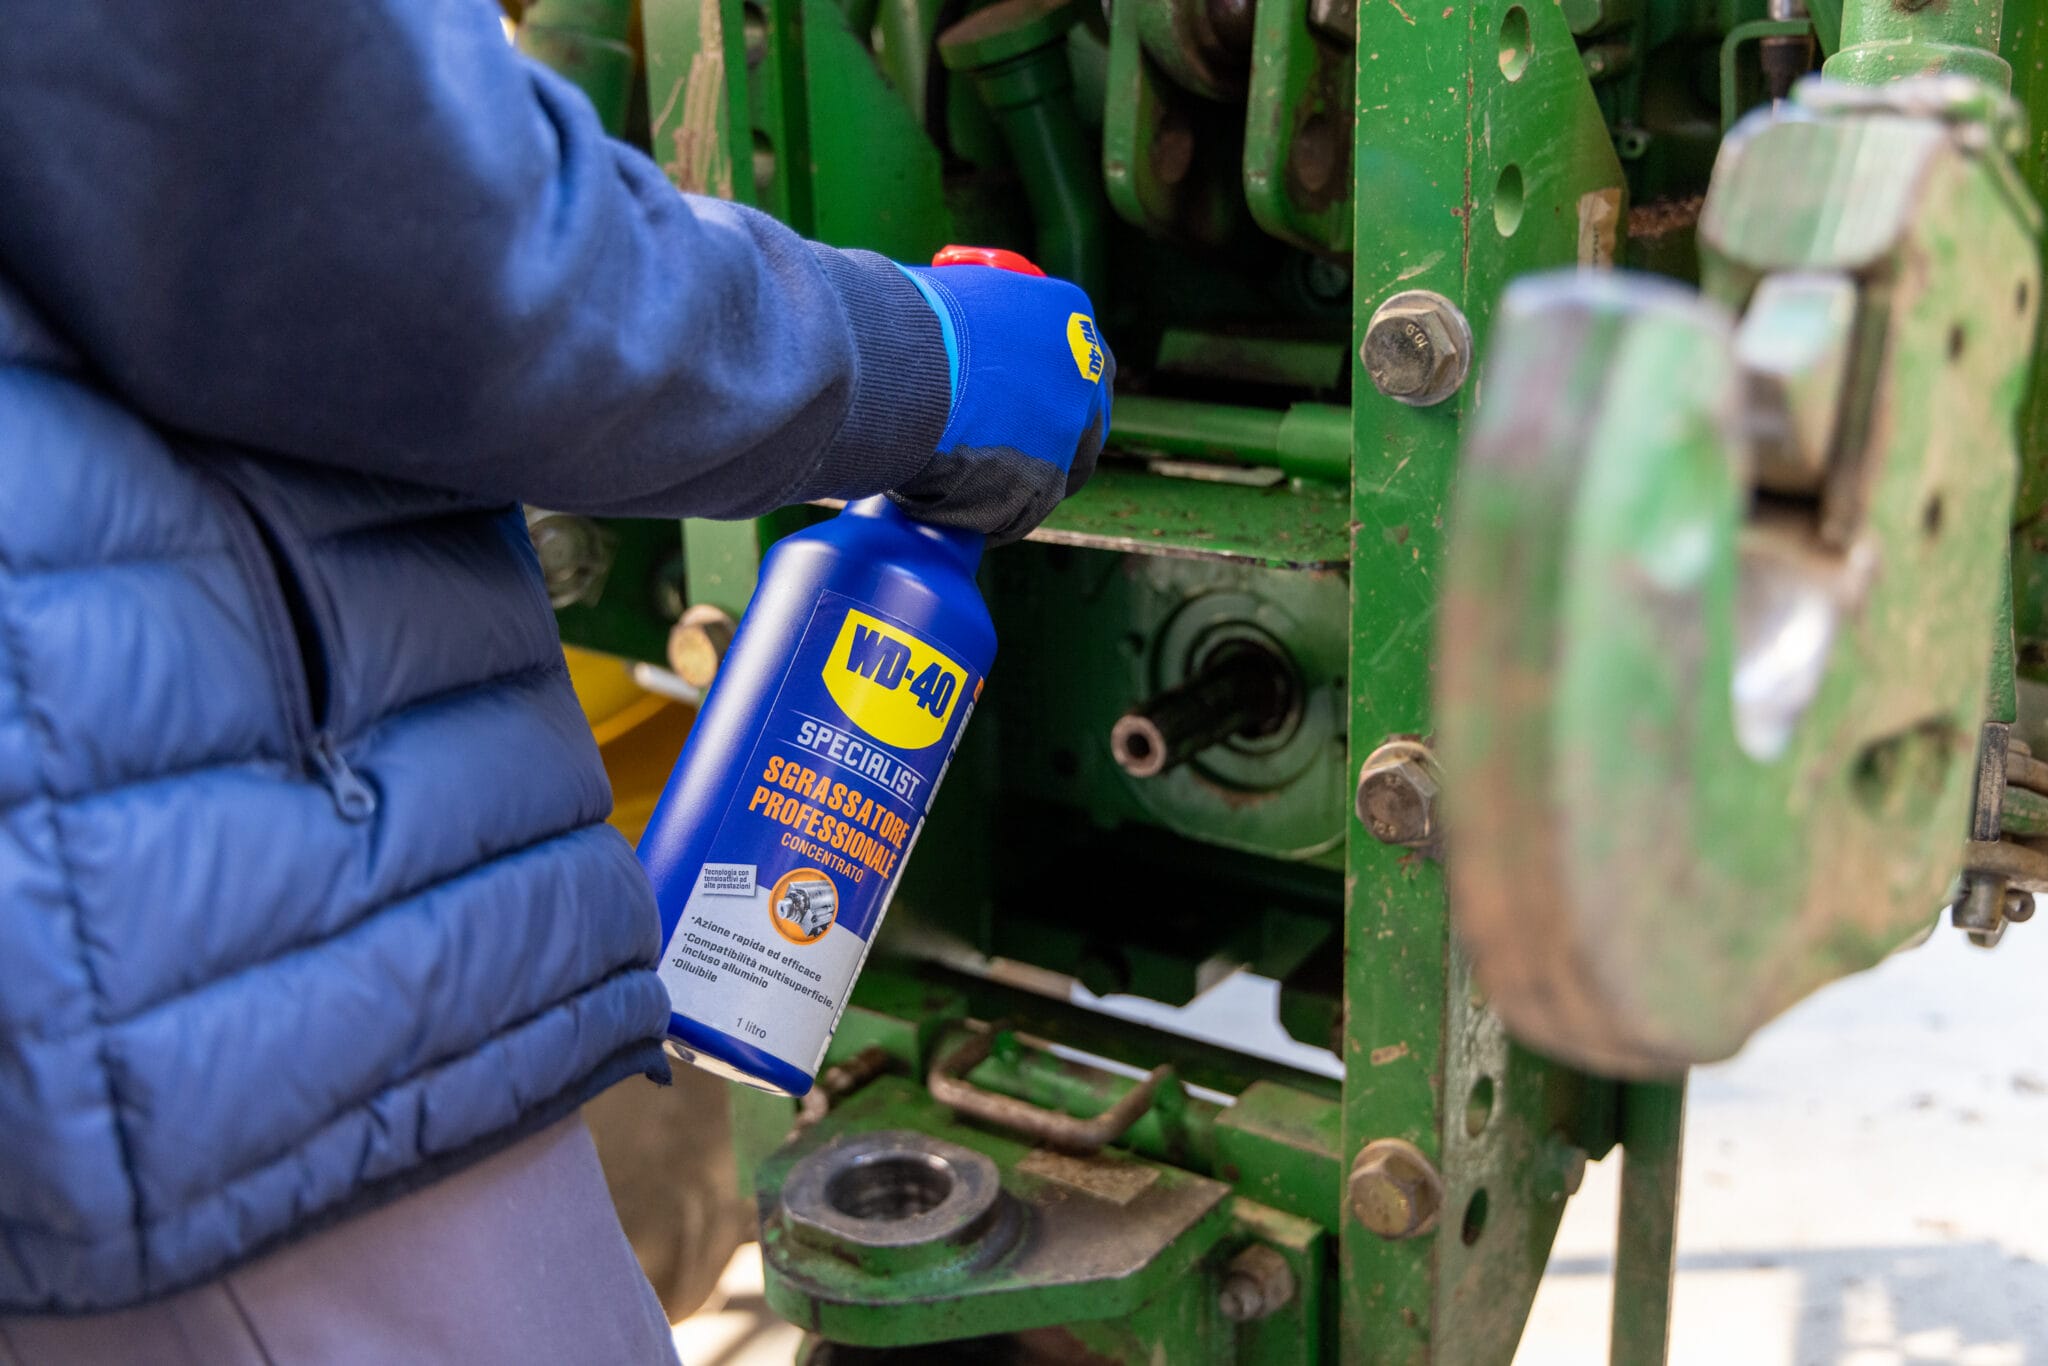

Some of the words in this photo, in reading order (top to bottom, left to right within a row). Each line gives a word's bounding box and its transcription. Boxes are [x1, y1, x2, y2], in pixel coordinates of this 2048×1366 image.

[1079, 320, 1102, 375] WD-40
[846, 623, 957, 719] WD-40
[797, 720, 920, 801] SPECIALIST
[763, 755, 911, 850] SGRASSATORE
[748, 785, 897, 880] PROFESSIONALE
[781, 832, 864, 884] CONCENTRATO
[704, 868, 737, 877] Tecnologia
[681, 944, 720, 967] incluso
[721, 961, 769, 989] alluminio
[733, 933, 766, 953] rapida
[767, 948, 781, 961] ed
[781, 956, 822, 983] efficace
[744, 1018, 767, 1040] litro
